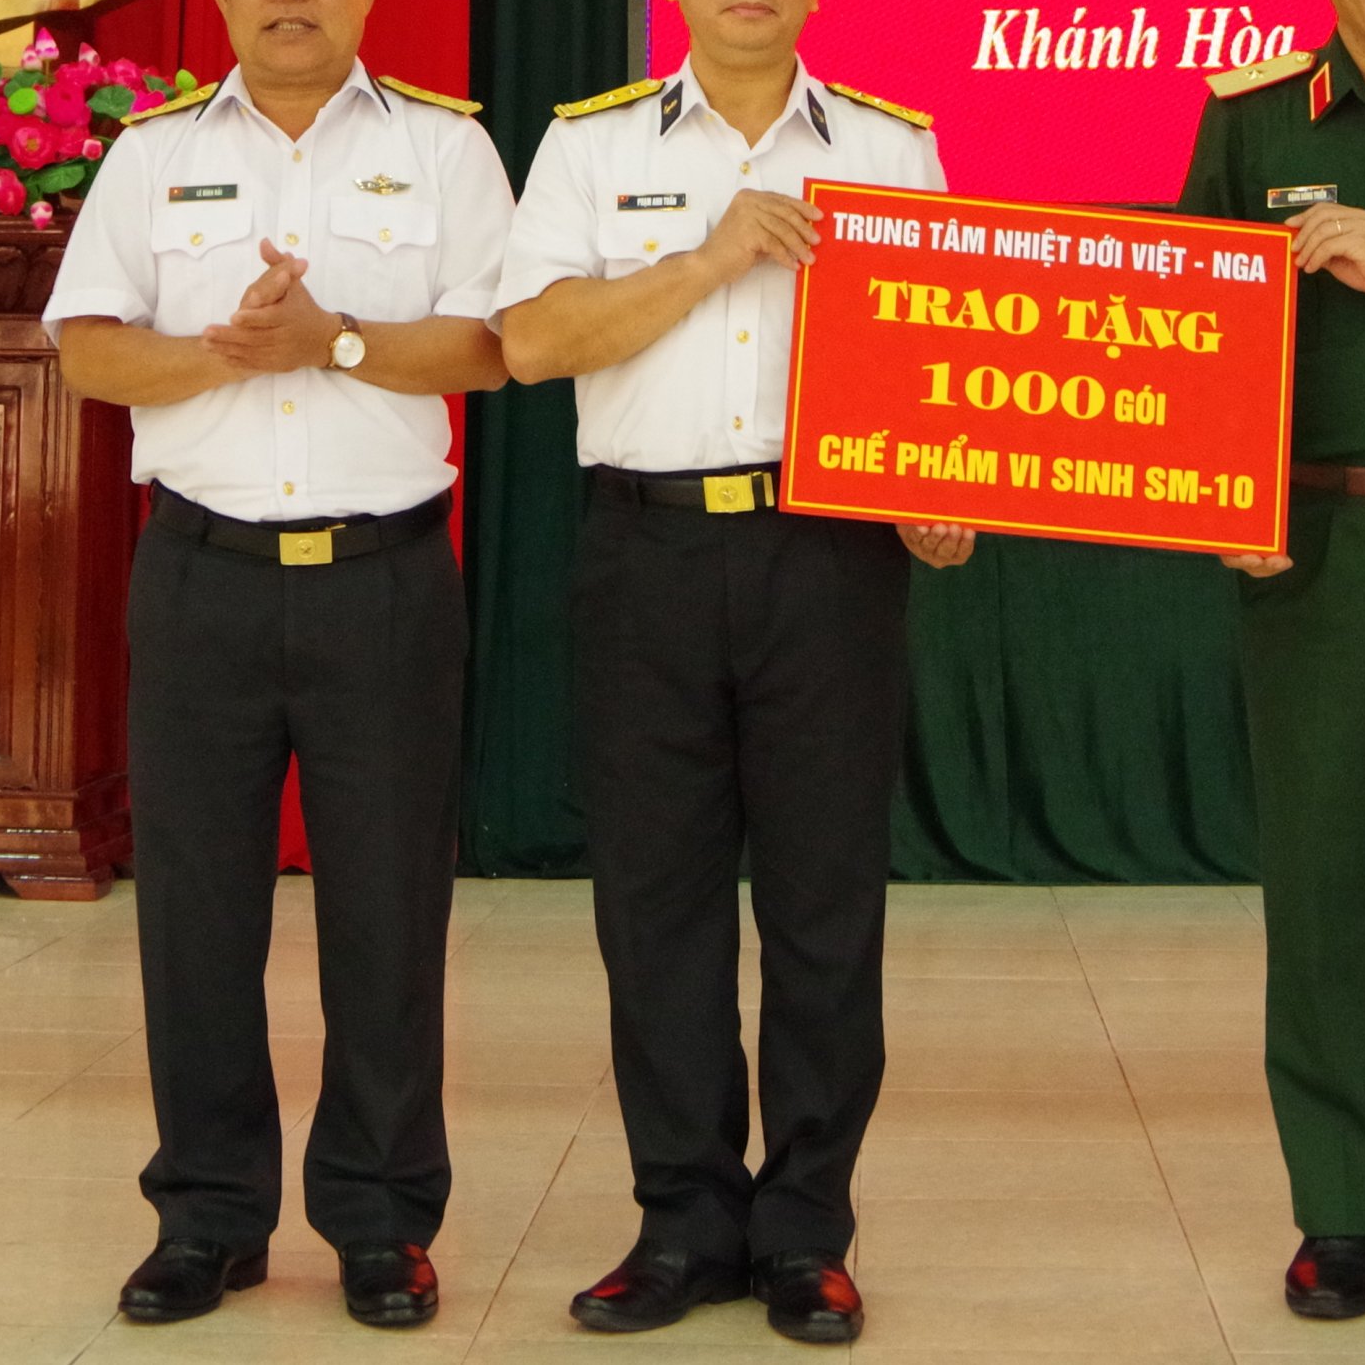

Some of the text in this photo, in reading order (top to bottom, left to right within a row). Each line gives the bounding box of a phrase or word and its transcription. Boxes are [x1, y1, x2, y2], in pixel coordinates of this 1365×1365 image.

[972, 7, 1158, 70] Khánh
[833, 212, 920, 248] TRUNG
[929, 218, 986, 254] TÂM
[994, 228, 1071, 267] NHIỆT
[1078, 234, 1123, 268] ĐỚI
[1131, 240, 1187, 279] VIỆT
[1212, 251, 1266, 283] NGA
[868, 277, 1223, 359] TRAO TẶNG
[921, 362, 1166, 425] 1000 GÓI
[819, 430, 1254, 509] CHẾ PHẨM VI SINH SM-10
